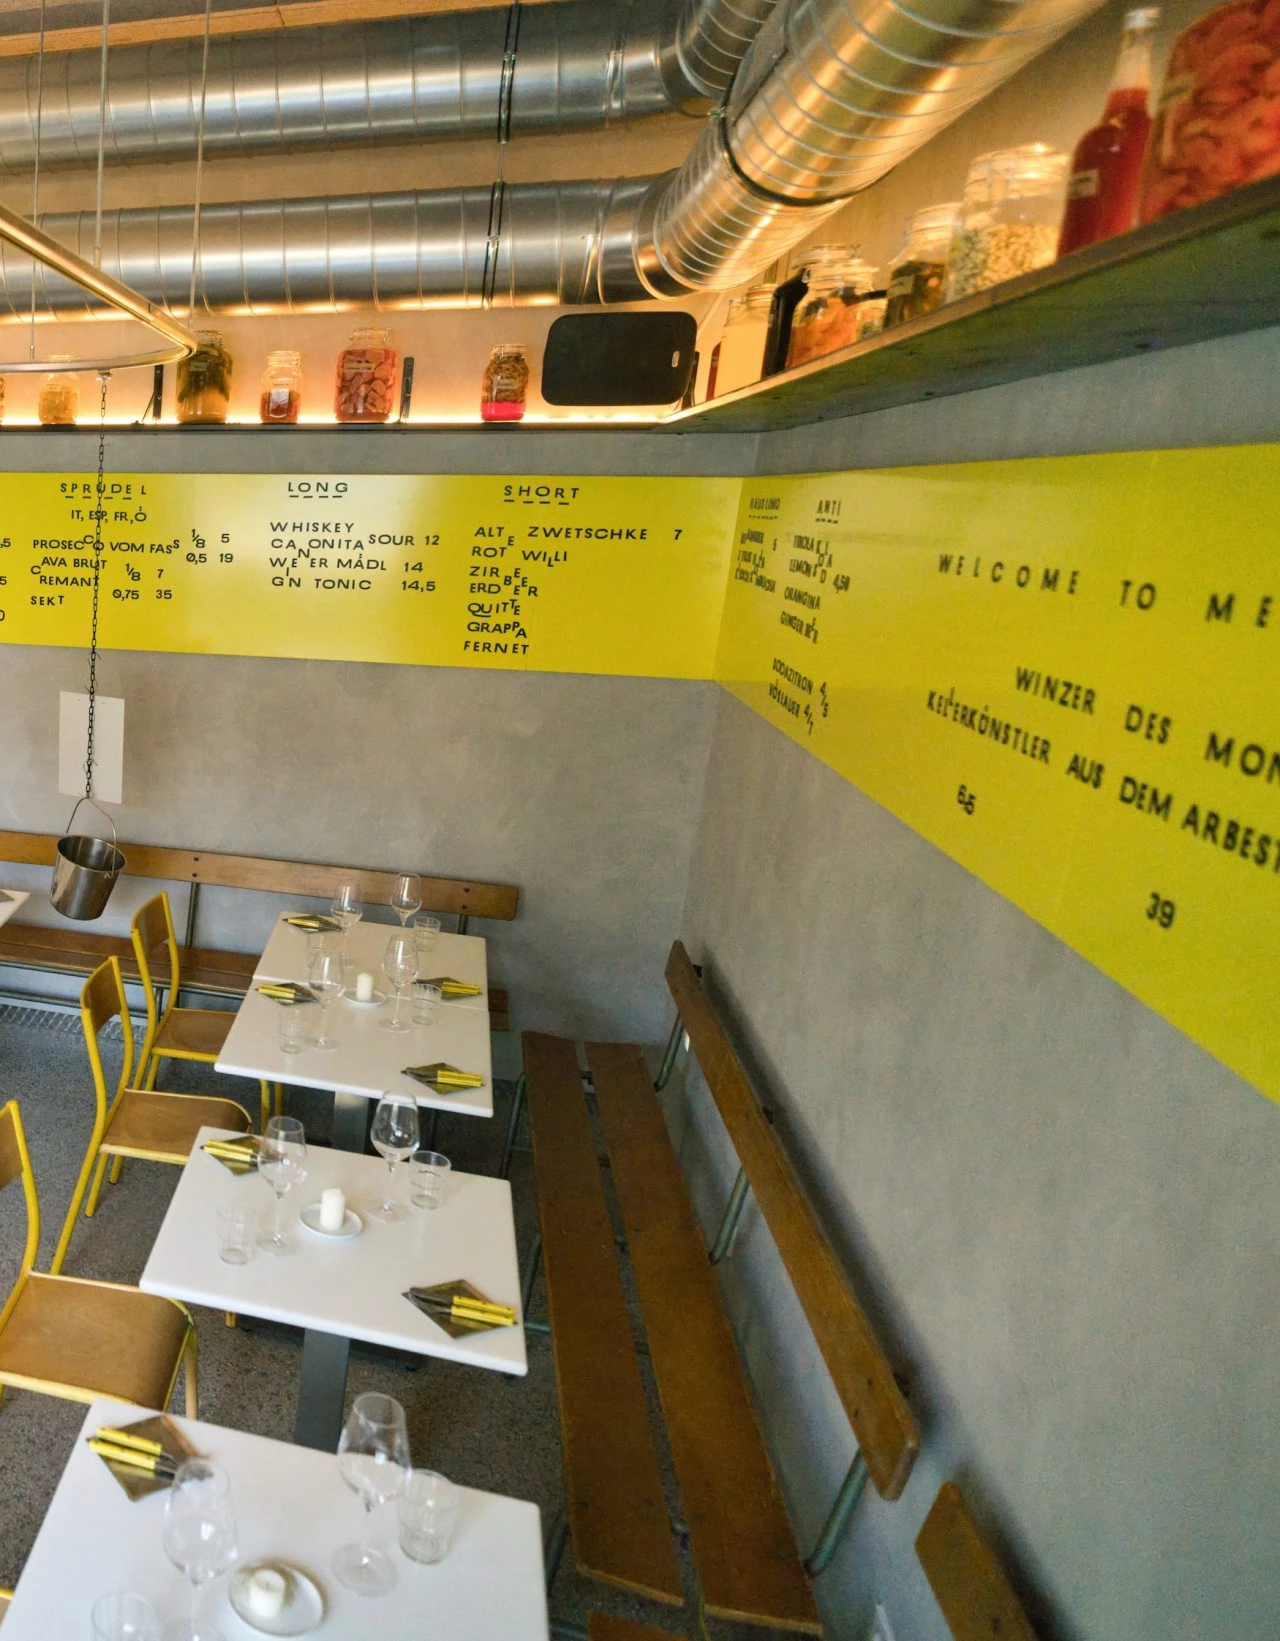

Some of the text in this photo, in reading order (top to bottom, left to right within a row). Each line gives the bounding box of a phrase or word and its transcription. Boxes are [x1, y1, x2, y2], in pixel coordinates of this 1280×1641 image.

[60, 483, 147, 495] SPRUDEL
[288, 482, 348, 493] LONG
[504, 486, 579, 499] SHORT
[817, 500, 841, 516] ANTI
[270, 522, 354, 533] WHISKEY
[527, 526, 648, 540] ZWETSCHKE
[674, 529, 683, 541] 7
[33, 535, 180, 554] PROSECCO VOM FASS
[221, 534, 230, 543] 5
[369, 534, 415, 546] SOUR
[425, 535, 440, 546] 12
[73, 559, 107, 569] BRUT
[186, 553, 233, 564] 0,5 19
[521, 550, 567, 567] WILLI
[157, 569, 164, 579] 7
[404, 562, 423, 572] 14
[789, 559, 812, 578] LEMON
[315, 579, 371, 590] TONIC
[401, 580, 436, 593] 14,5
[938, 553, 1080, 595] WELCOME
[1119, 579, 1157, 611] TO
[31, 596, 64, 606] SEKT
[113, 589, 172, 600] 0,75 35
[784, 586, 820, 610] ORANGINA
[467, 599, 521, 618] QUITTE
[467, 621, 527, 638] GRAPPA
[780, 611, 804, 636] GINGER
[463, 640, 529, 655] FERNET
[773, 657, 814, 695] SODAZITRON
[1015, 665, 1097, 716] WINZER
[1124, 704, 1172, 746] DES
[1065, 754, 1105, 790] AUS
[1119, 775, 1174, 822] DEM
[1145, 891, 1177, 930] 39
